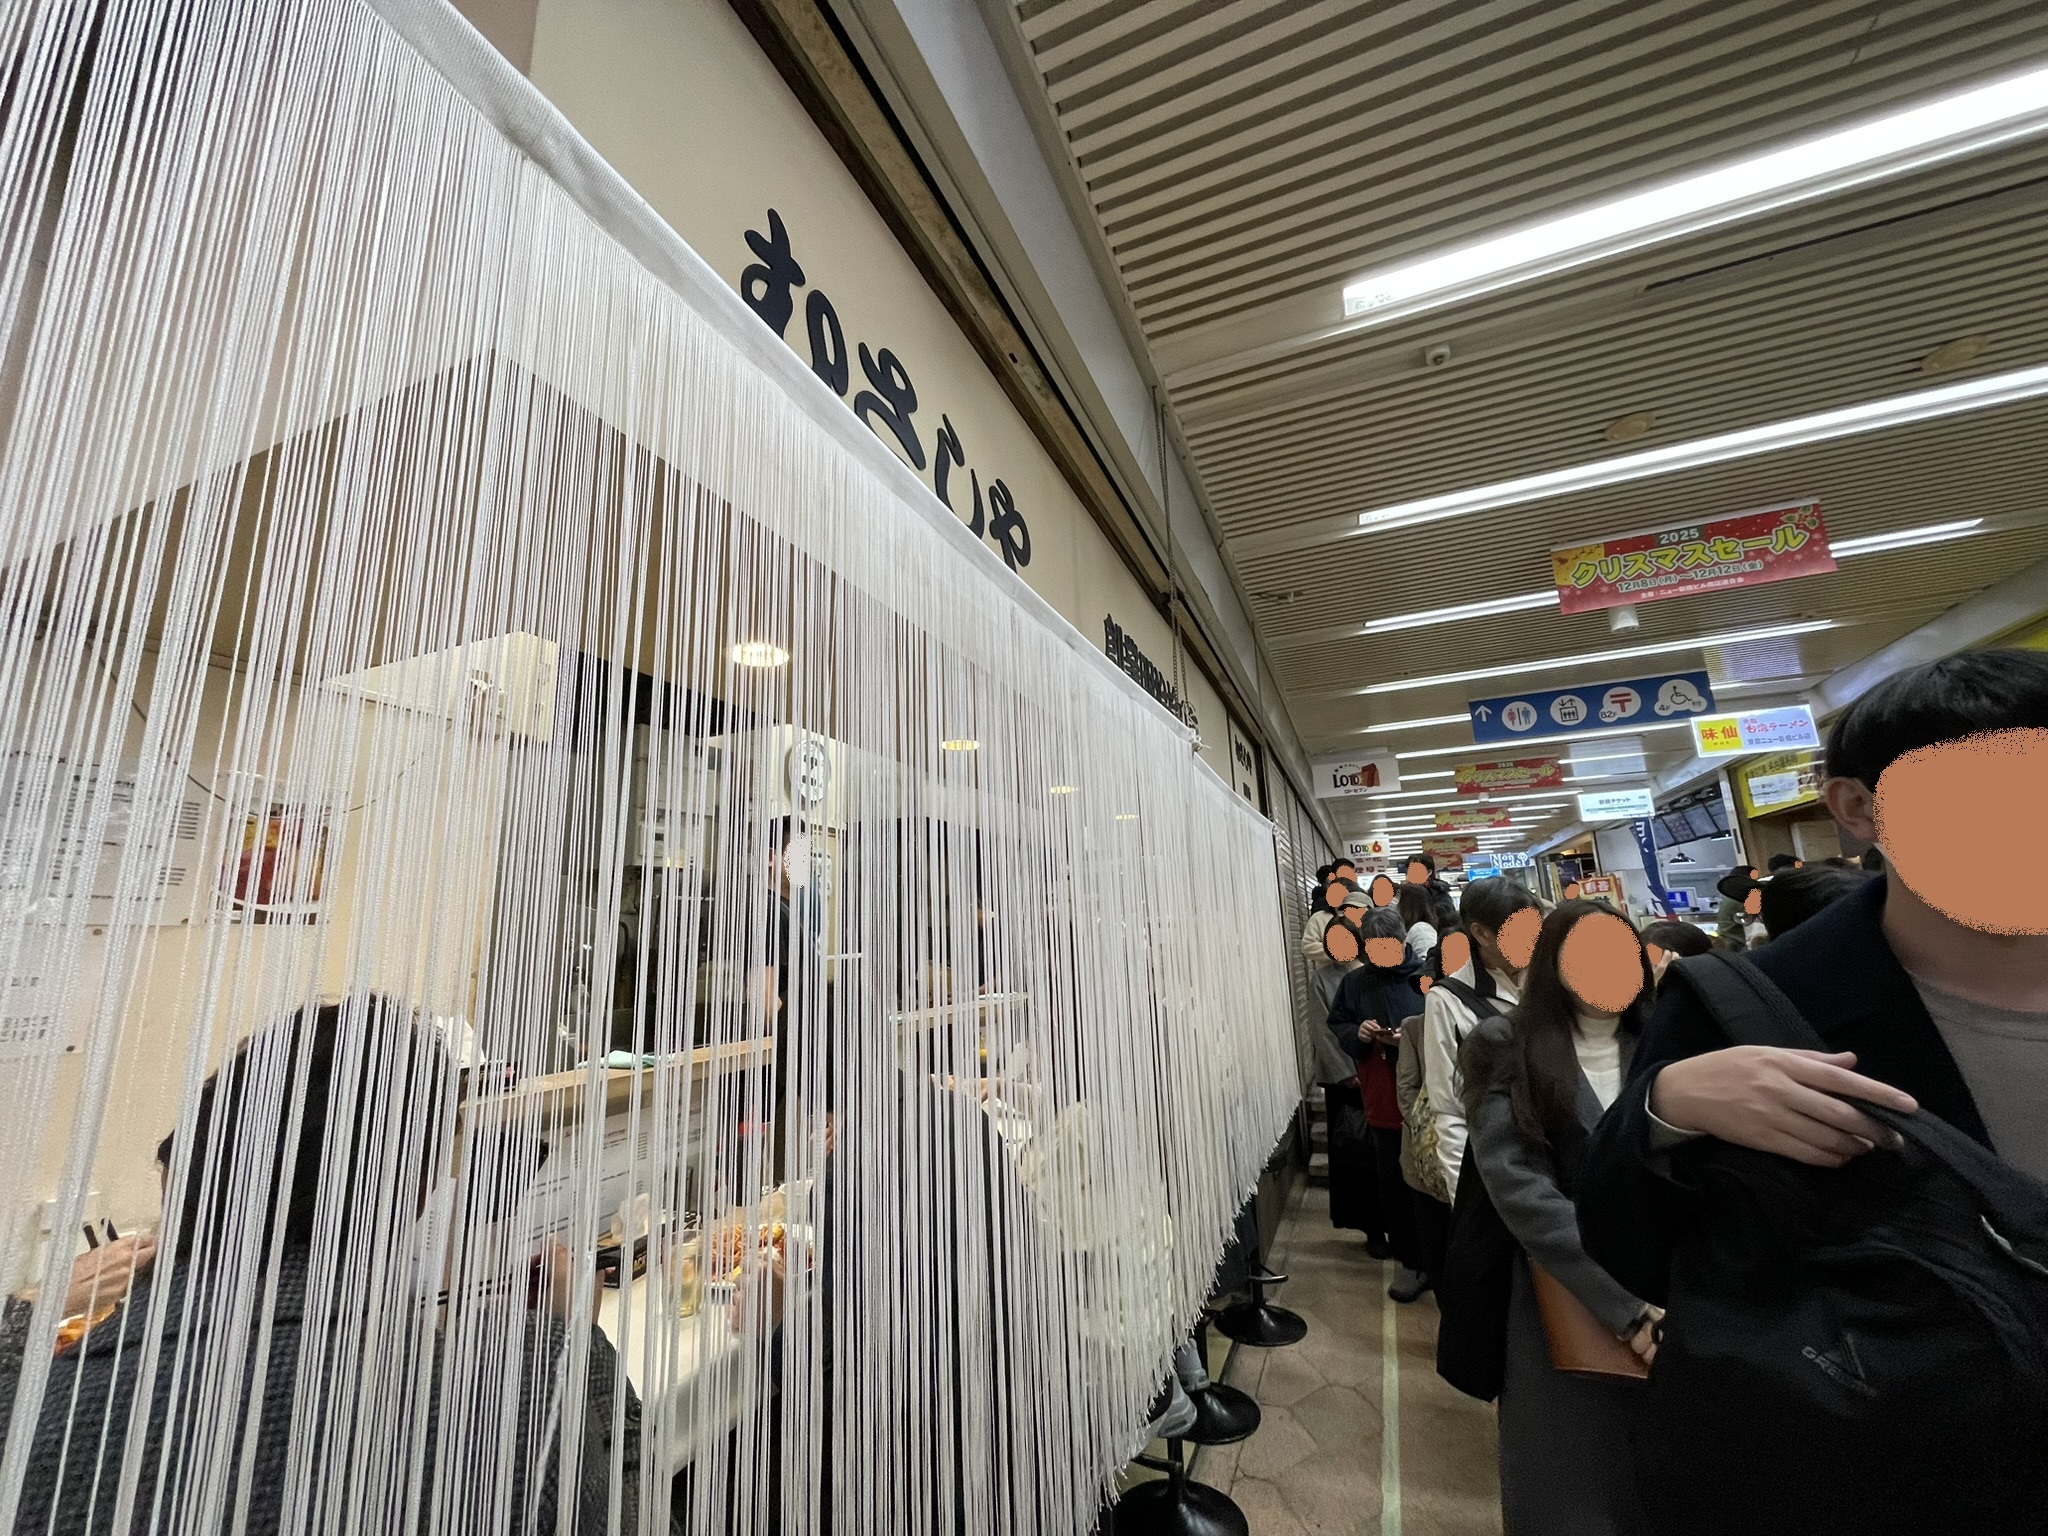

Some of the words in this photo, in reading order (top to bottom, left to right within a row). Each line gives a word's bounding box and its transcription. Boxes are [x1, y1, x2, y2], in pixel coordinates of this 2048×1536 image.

[1660, 528, 1700, 544] 2025
[1571, 525, 1809, 587] クリスマスセール
[1601, 710, 1617, 719] B2F
[1701, 724, 1739, 741] 味仙
[1350, 843, 1369, 854] LOTO
[1372, 840, 1382, 853] 6
[1492, 853, 1514, 861] Mon
[1493, 859, 1525, 868] Model
